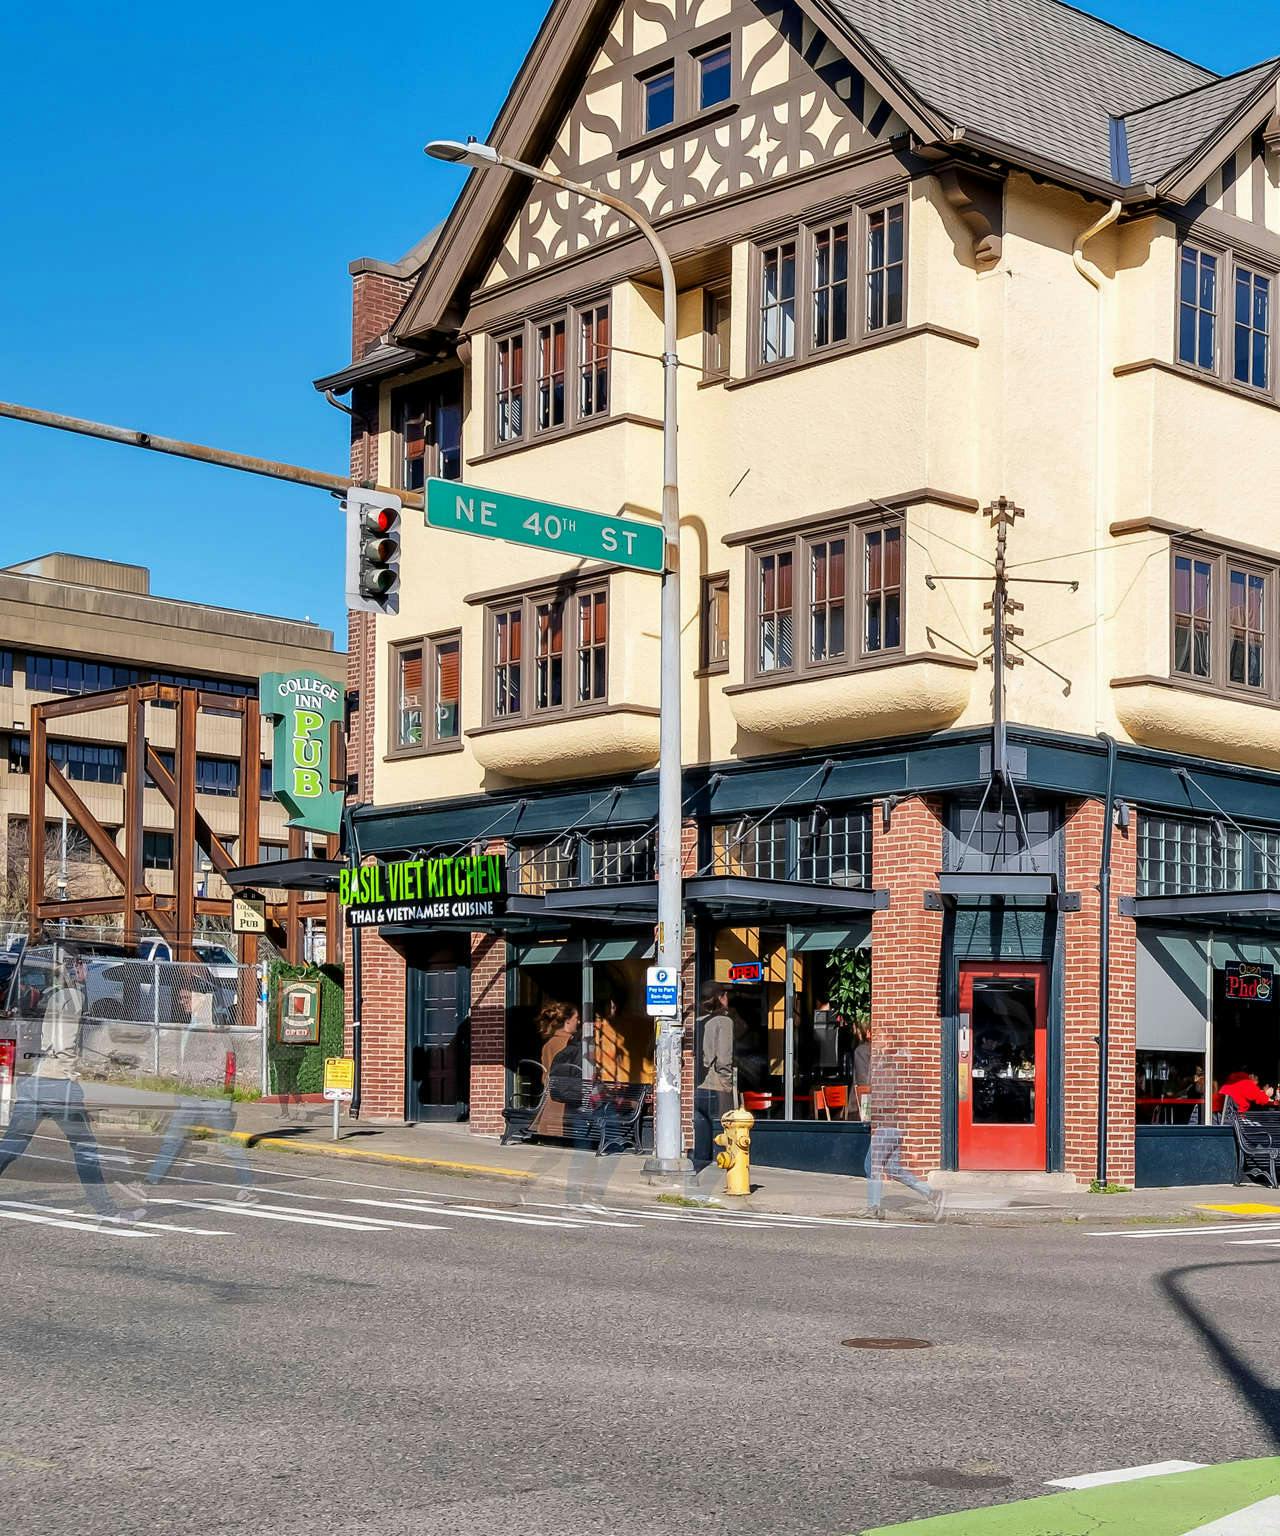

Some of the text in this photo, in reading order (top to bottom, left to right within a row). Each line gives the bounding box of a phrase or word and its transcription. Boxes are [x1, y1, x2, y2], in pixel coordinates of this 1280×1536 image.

[455, 495, 638, 555] NE 40TH ST
[278, 678, 340, 703] COLLEGE
[295, 693, 322, 709] INN
[293, 709, 324, 798] PUB
[339, 854, 501, 906] BASIL VIET KITCHEN
[351, 901, 494, 924] THAI & VIETNAMESE CUISINE
[728, 964, 760, 980] OPEN
